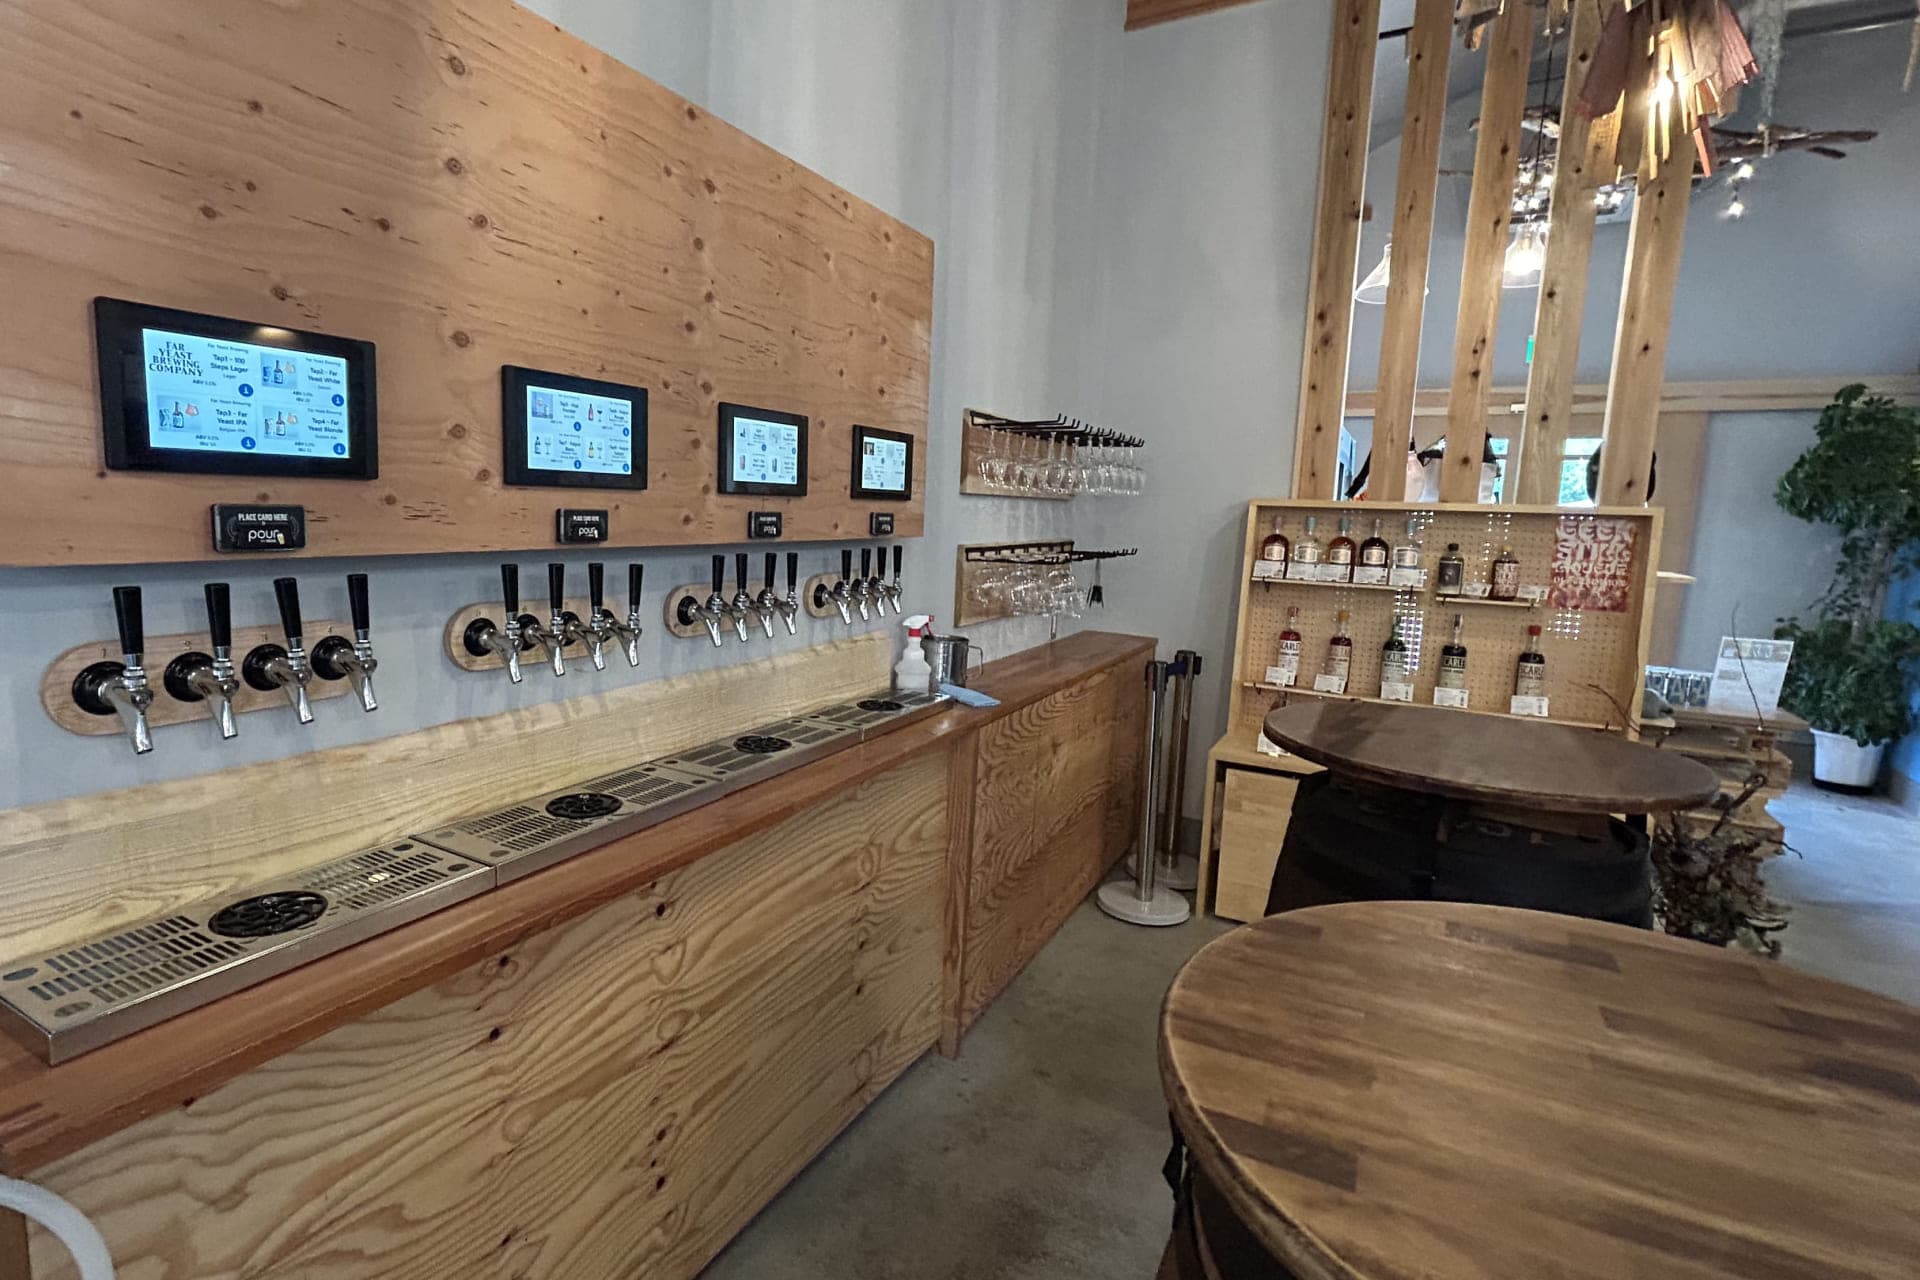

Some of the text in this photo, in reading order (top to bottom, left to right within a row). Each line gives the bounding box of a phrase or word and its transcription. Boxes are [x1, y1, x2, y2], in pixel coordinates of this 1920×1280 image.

[166, 342, 185, 351] FAR
[158, 348, 192, 360] YEAST
[152, 356, 200, 368] BREWING
[149, 363, 202, 376] COMPANY
[230, 366, 248, 374] Lager
[248, 529, 279, 542] pour
